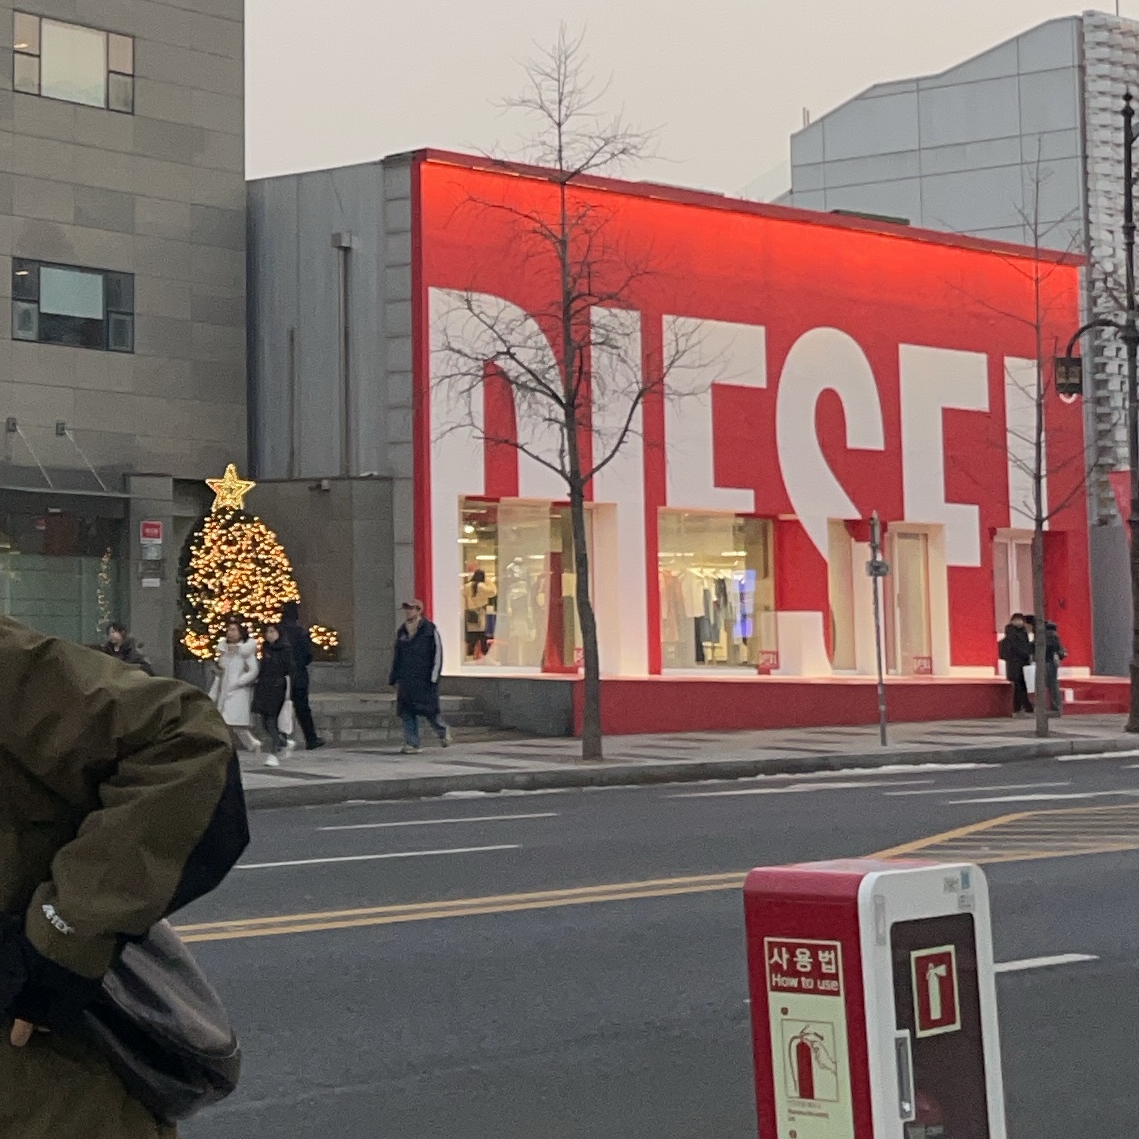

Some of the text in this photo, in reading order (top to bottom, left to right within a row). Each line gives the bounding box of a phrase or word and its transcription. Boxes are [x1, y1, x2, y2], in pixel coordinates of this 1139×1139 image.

[769, 946, 837, 973] 사용법
[772, 973, 839, 991] How to use
